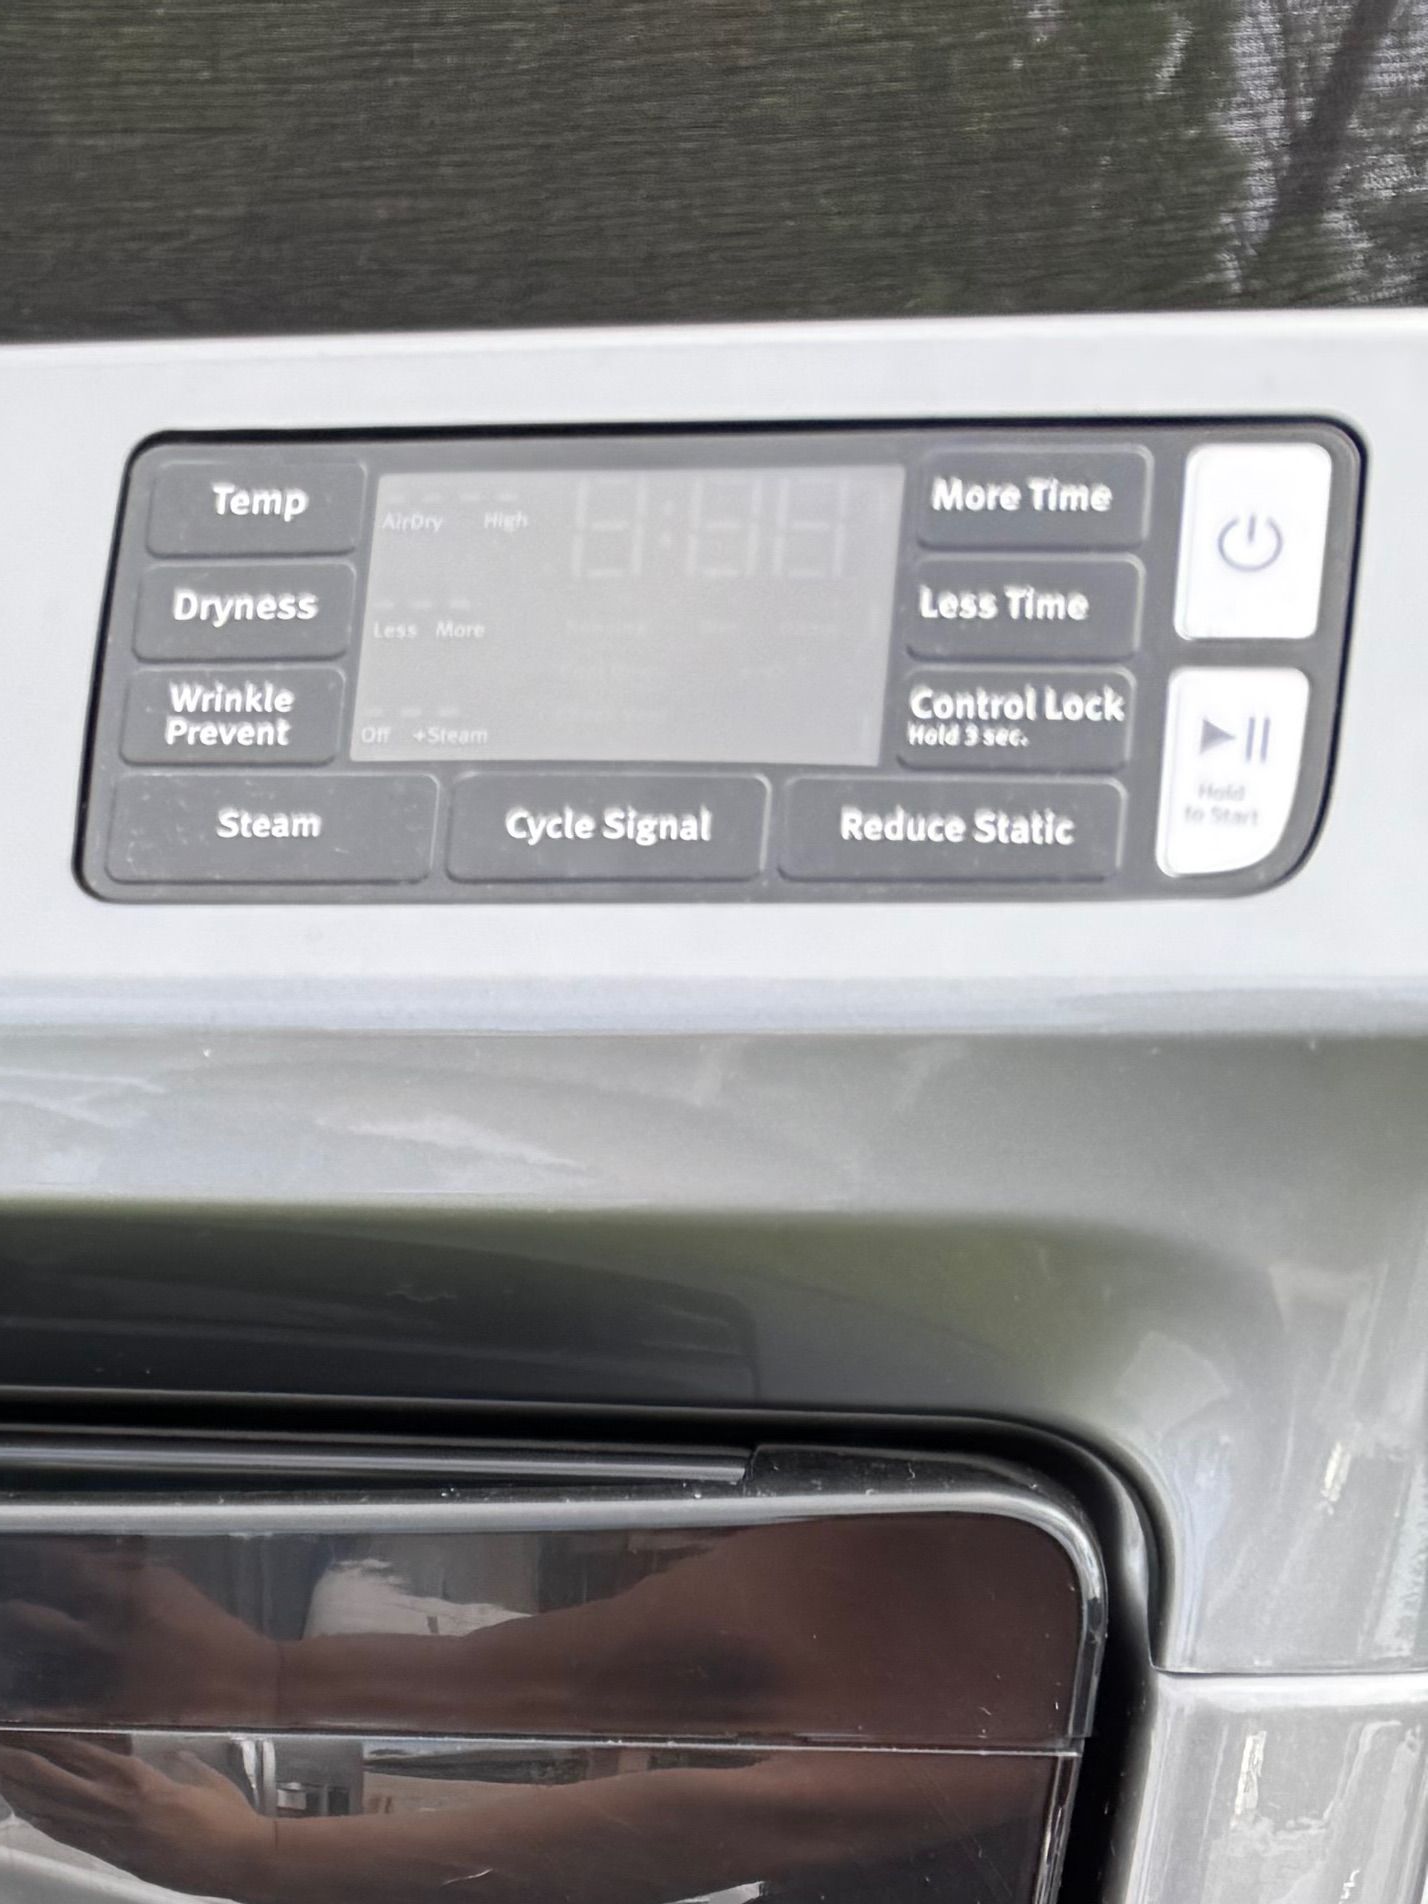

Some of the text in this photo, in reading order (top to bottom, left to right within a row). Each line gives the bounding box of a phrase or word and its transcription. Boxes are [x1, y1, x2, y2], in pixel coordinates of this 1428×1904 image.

[211, 481, 310, 522] Temp
[931, 475, 1113, 512] More Time
[483, 510, 529, 534] High
[173, 587, 319, 628] Dryness
[919, 584, 1090, 621] Less Time
[373, 620, 418, 640] Less
[435, 619, 486, 640] More
[169, 681, 295, 713] Wrinkle
[909, 683, 1126, 721] Control Lock
[165, 715, 292, 746] Prevent
[360, 726, 392, 744] Off
[907, 720, 1030, 747] Hold 3 sec.
[1198, 783, 1246, 801] Hold
[216, 807, 322, 838] Steam
[505, 804, 714, 846] Cycle Signal
[840, 804, 1076, 846] Reduce Static
[1184, 805, 1259, 827] to Start
